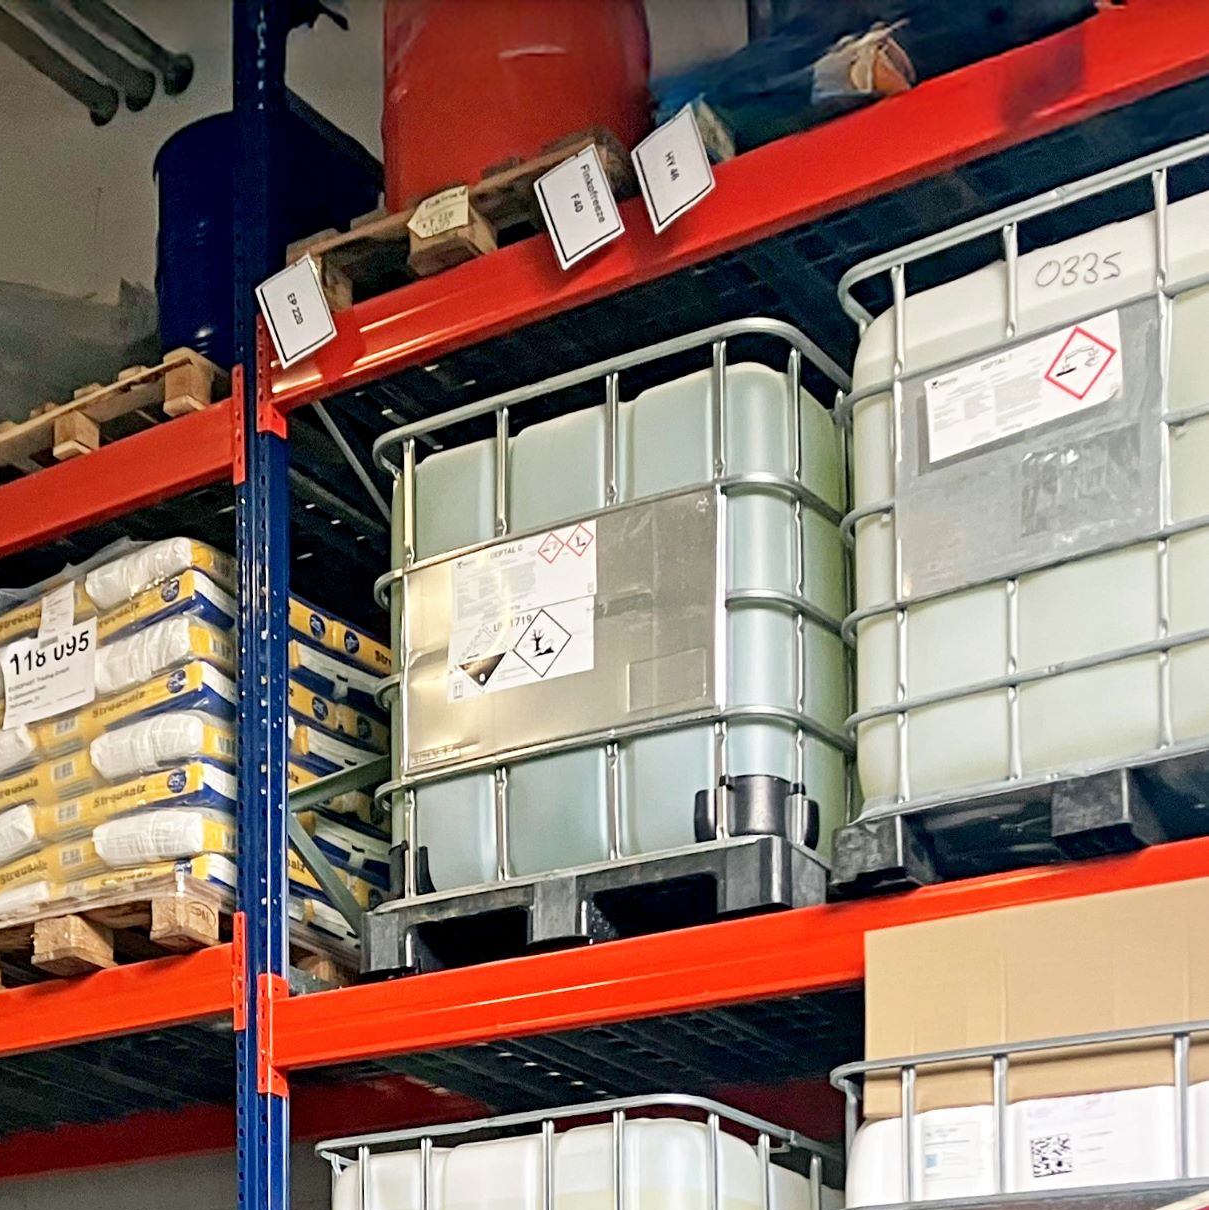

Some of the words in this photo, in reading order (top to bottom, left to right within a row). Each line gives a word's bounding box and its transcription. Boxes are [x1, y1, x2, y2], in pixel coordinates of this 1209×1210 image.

[664, 151, 676, 167] HY
[570, 193, 583, 214] F40
[1035, 251, 1122, 288] 0335
[287, 292, 298, 305] EP
[292, 306, 304, 325] 220
[510, 614, 533, 627] 1719
[10, 650, 46, 675] 118
[93, 784, 146, 808] Streusalz
